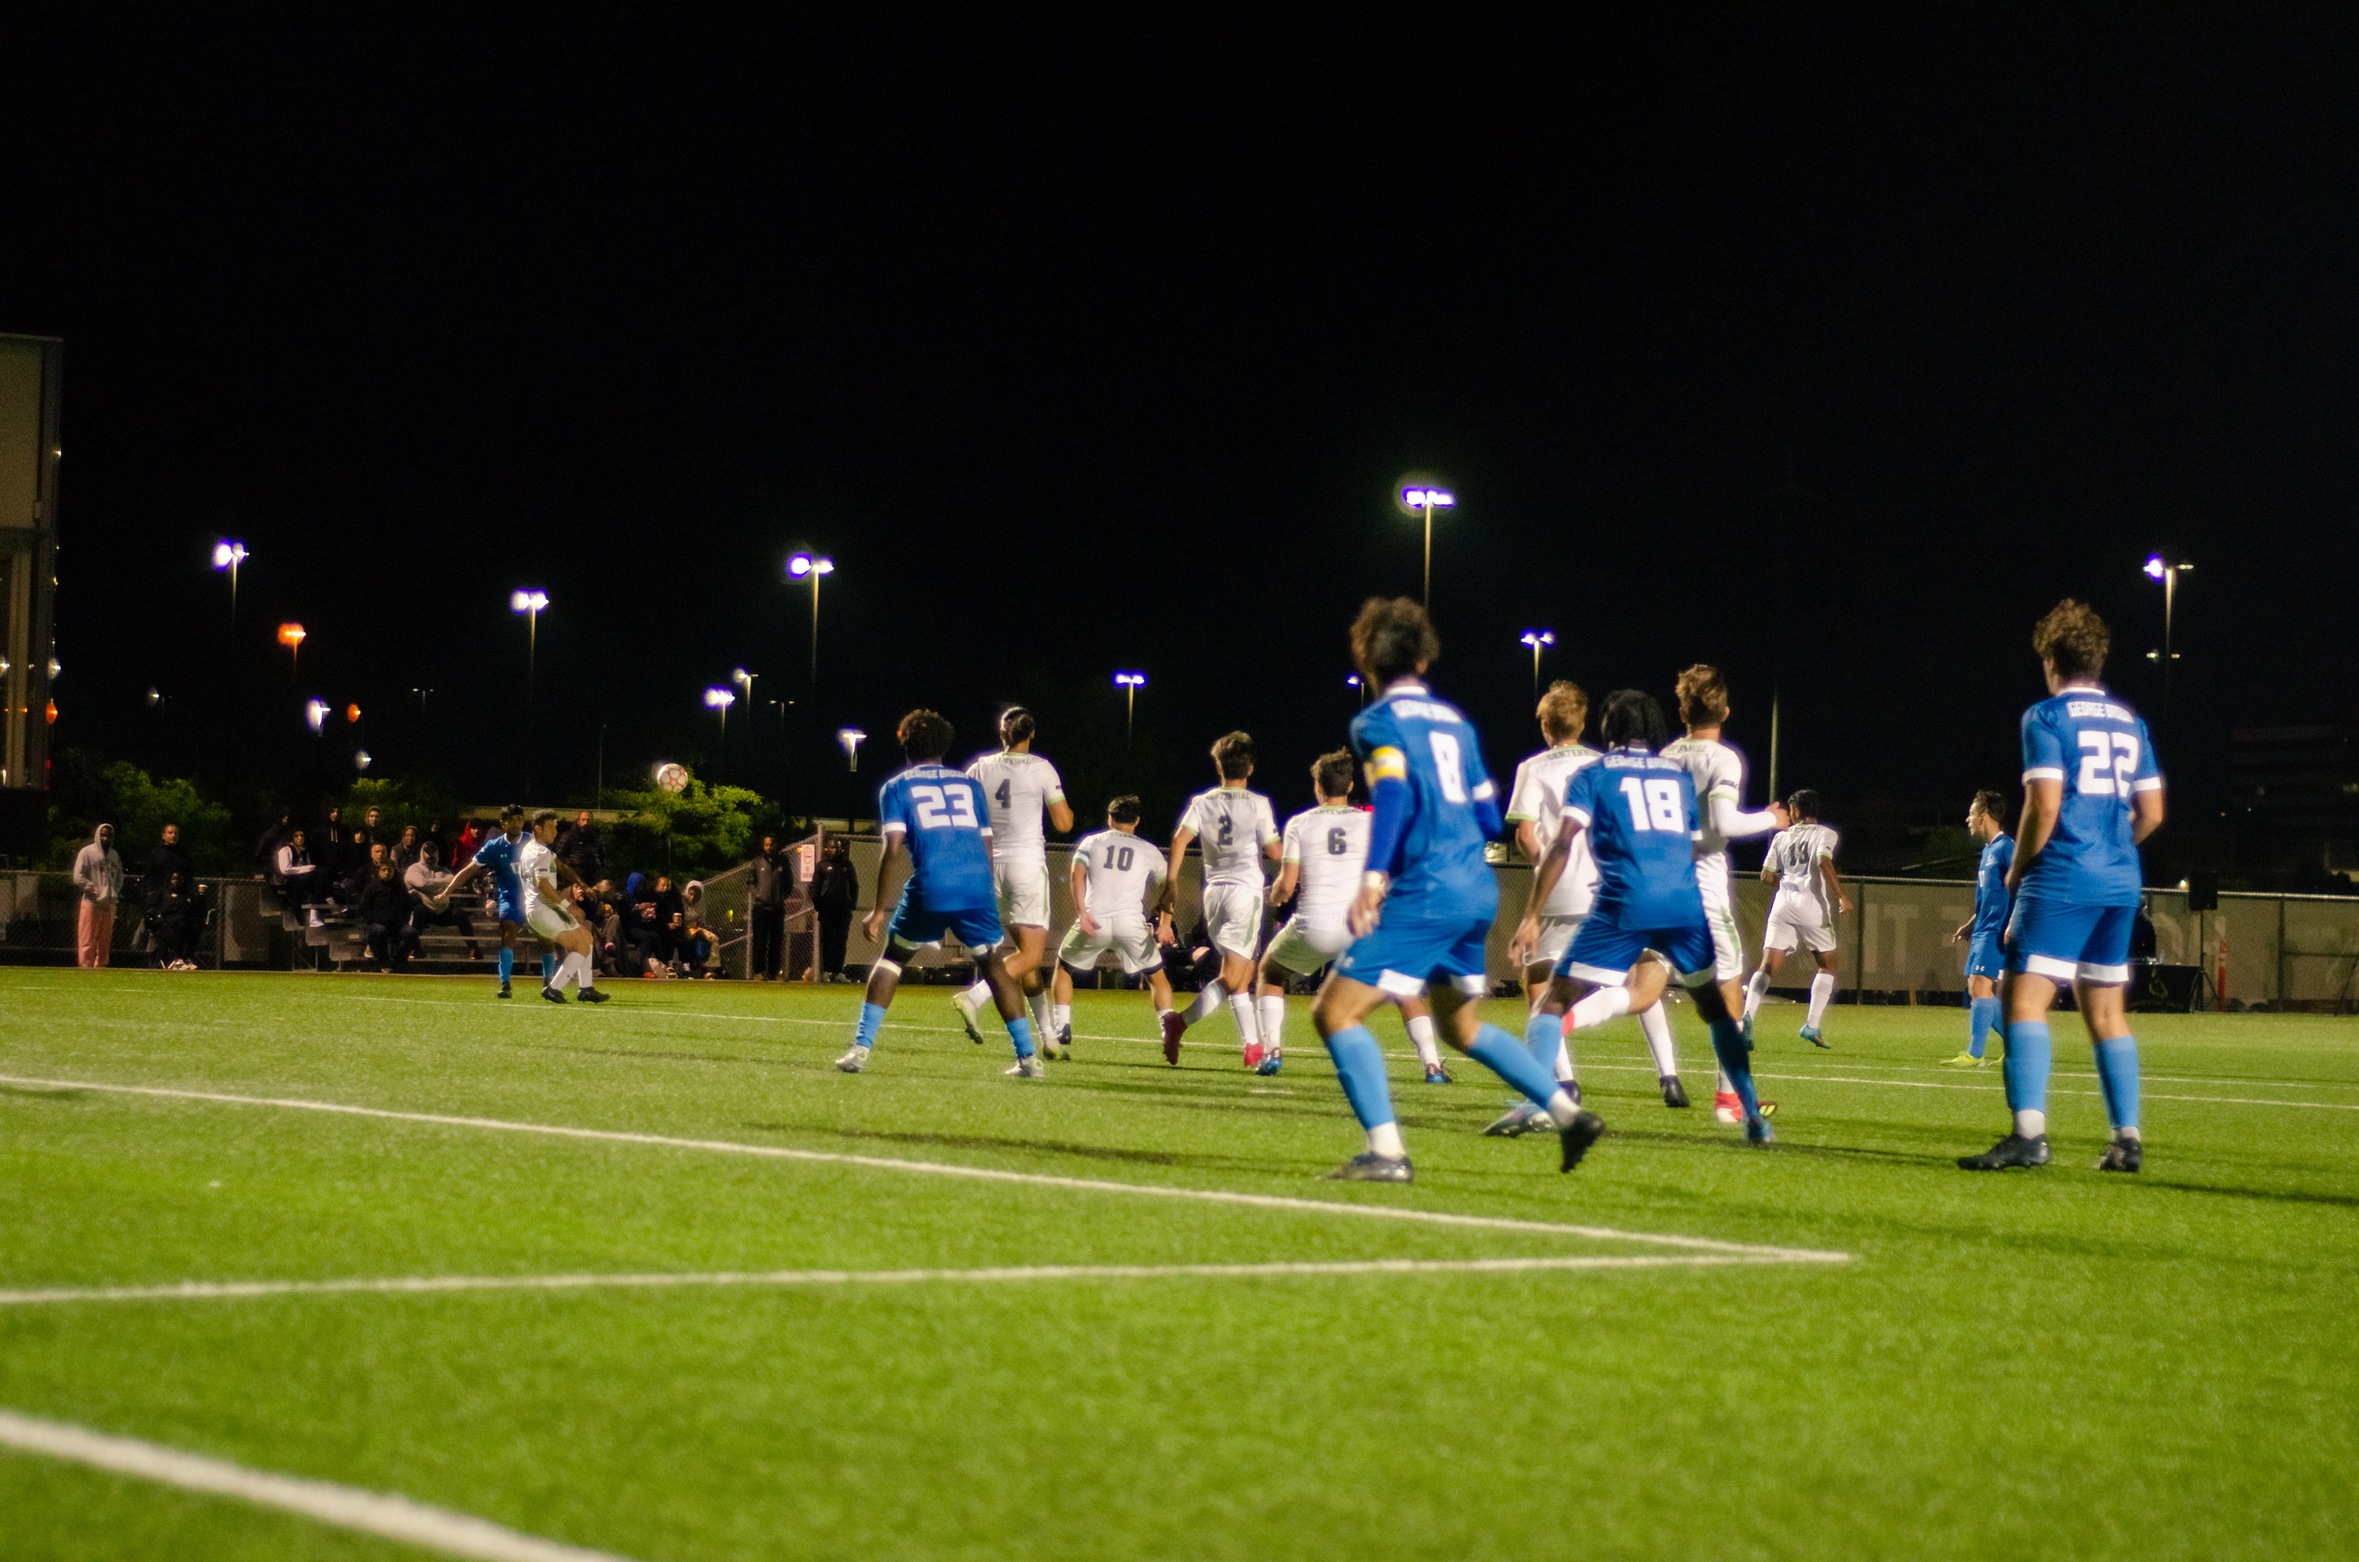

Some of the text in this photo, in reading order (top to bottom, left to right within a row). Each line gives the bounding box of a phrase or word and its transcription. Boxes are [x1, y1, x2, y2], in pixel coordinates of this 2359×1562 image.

[1428, 730, 1467, 803] 8
[2077, 730, 2139, 798] 22
[911, 784, 979, 829] 23
[995, 778, 1011, 809] 4
[1620, 777, 1685, 833] 18
[1217, 814, 1233, 847] 2
[1327, 827, 1347, 856] 6
[1103, 845, 1135, 872] 10
